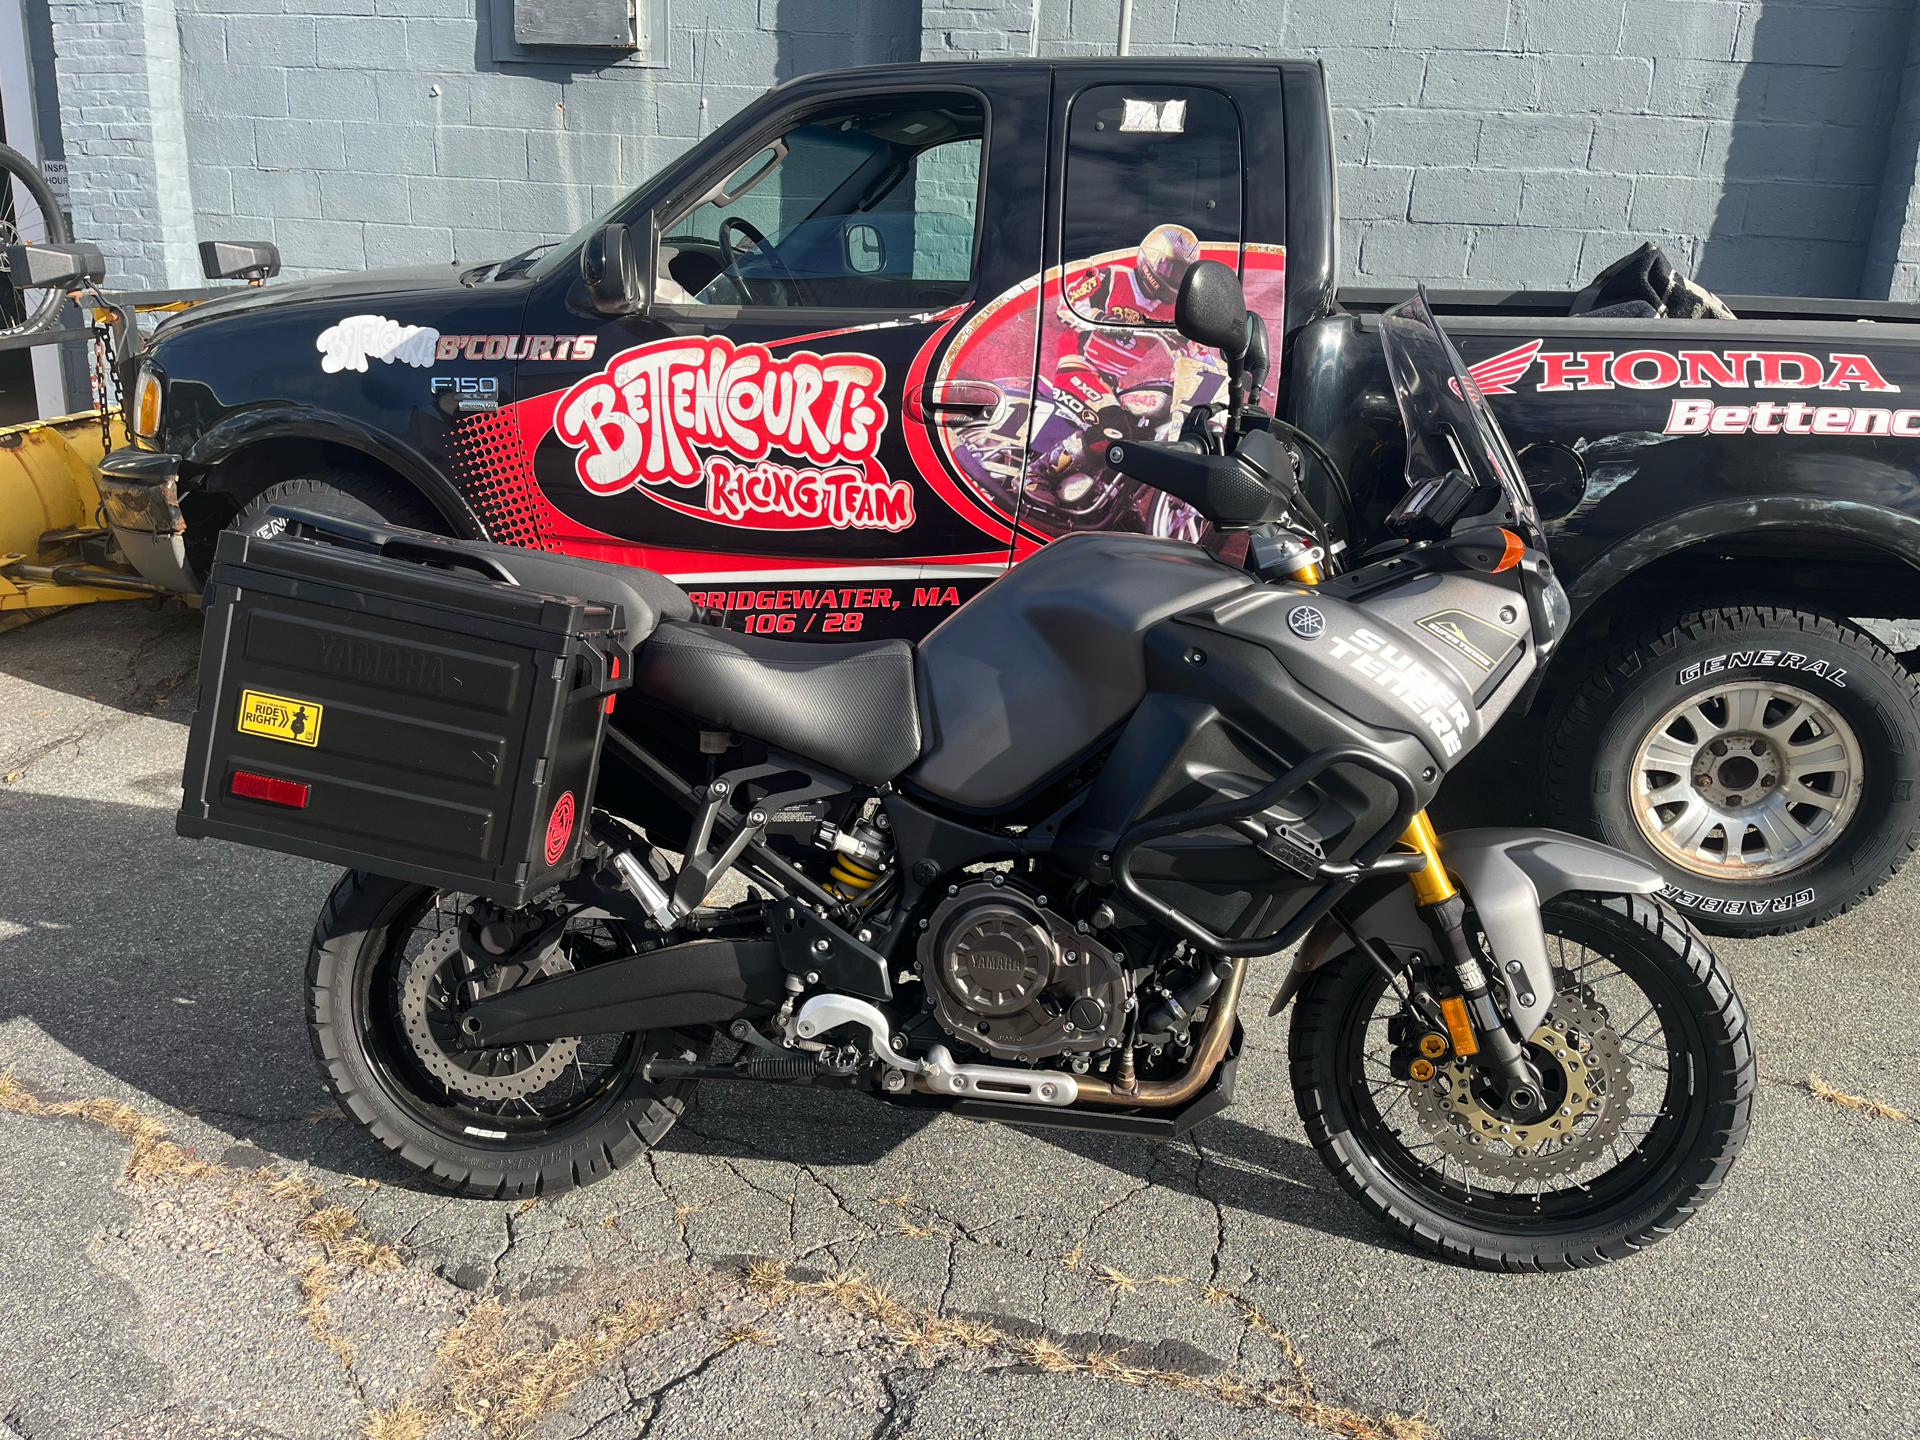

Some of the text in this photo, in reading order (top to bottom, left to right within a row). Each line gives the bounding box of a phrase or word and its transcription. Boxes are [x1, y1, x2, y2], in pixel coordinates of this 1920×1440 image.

[435, 334, 599, 361] B'COURTS
[430, 376, 497, 394] F-150
[1536, 350, 1902, 393] HONDA
[707, 462, 913, 530] RACING TEAM
[688, 586, 961, 611] BRIDGEWATER, MA
[744, 613, 797, 634] 106
[822, 612, 864, 632] 28
[316, 632, 445, 692] YAMAHA
[1678, 649, 1848, 688] GENERAL
[1347, 627, 1471, 735] SUPER
[246, 712, 279, 727] RIGHT
[255, 704, 280, 718] RIDE
[1656, 881, 1815, 916] GRABBER
[970, 954, 1021, 972] YAMAHA
